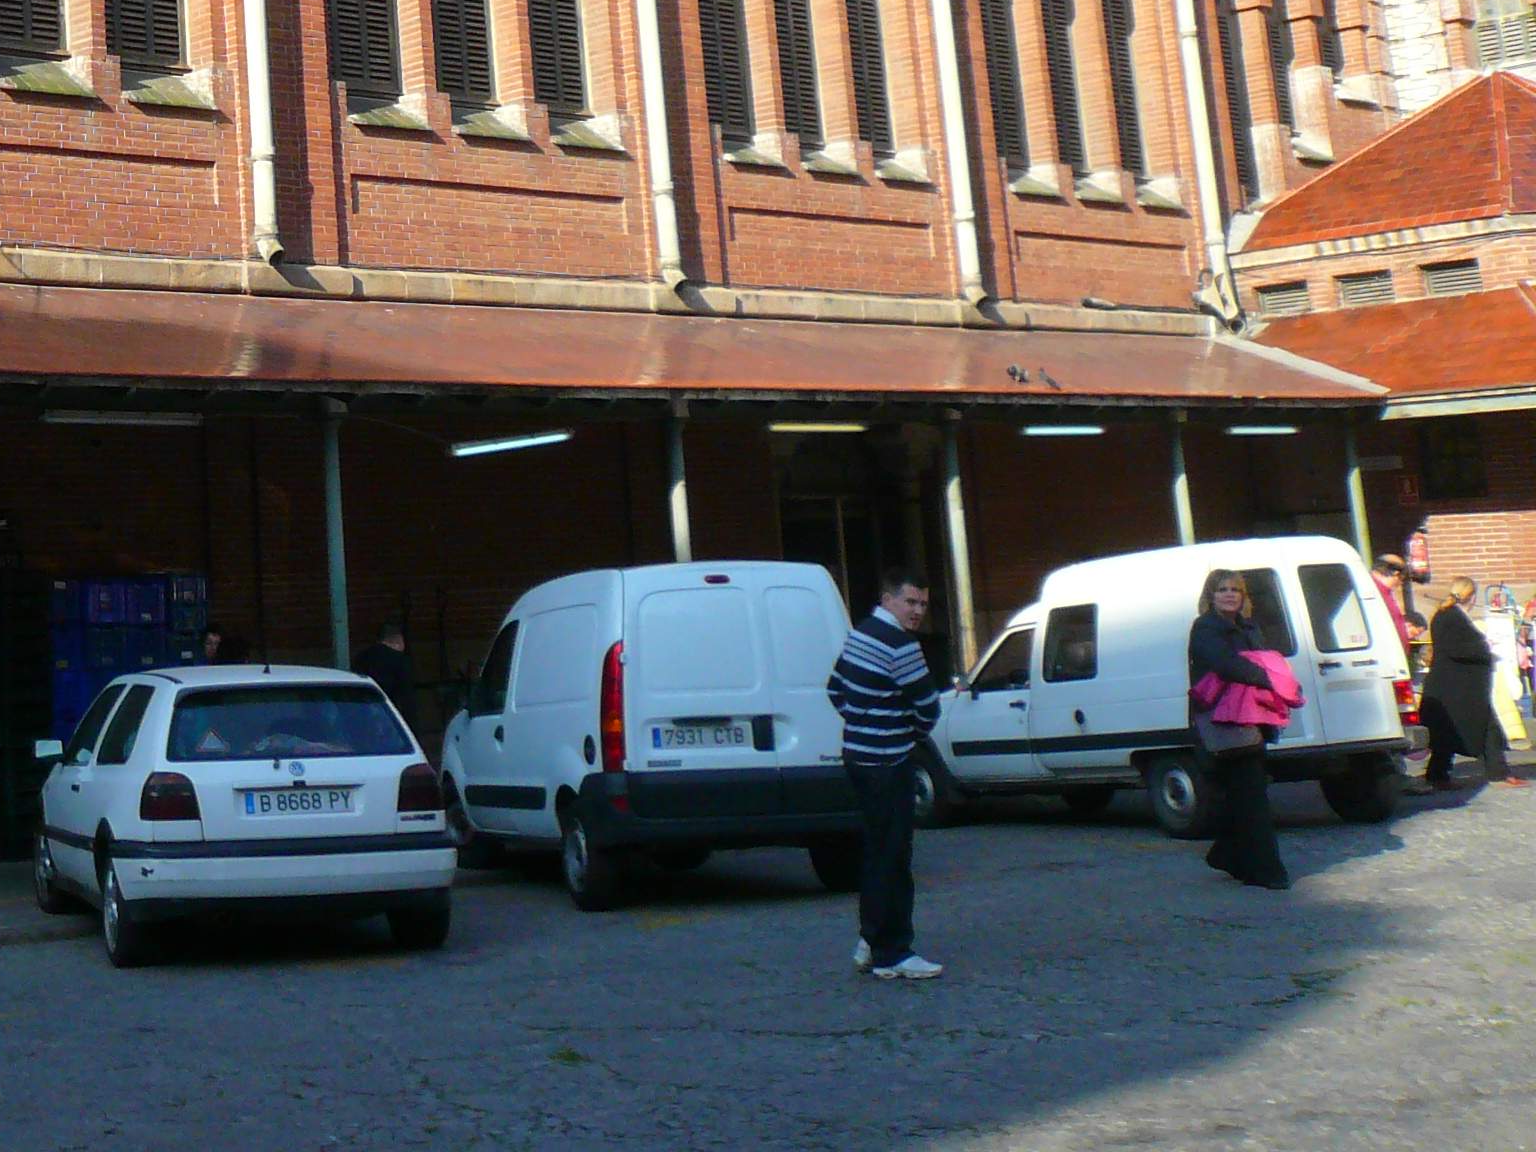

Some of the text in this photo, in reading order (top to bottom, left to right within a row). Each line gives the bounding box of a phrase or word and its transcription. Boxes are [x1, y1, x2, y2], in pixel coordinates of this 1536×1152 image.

[664, 727, 744, 746] 7931 CTB
[260, 791, 351, 813] B 8668 PY
